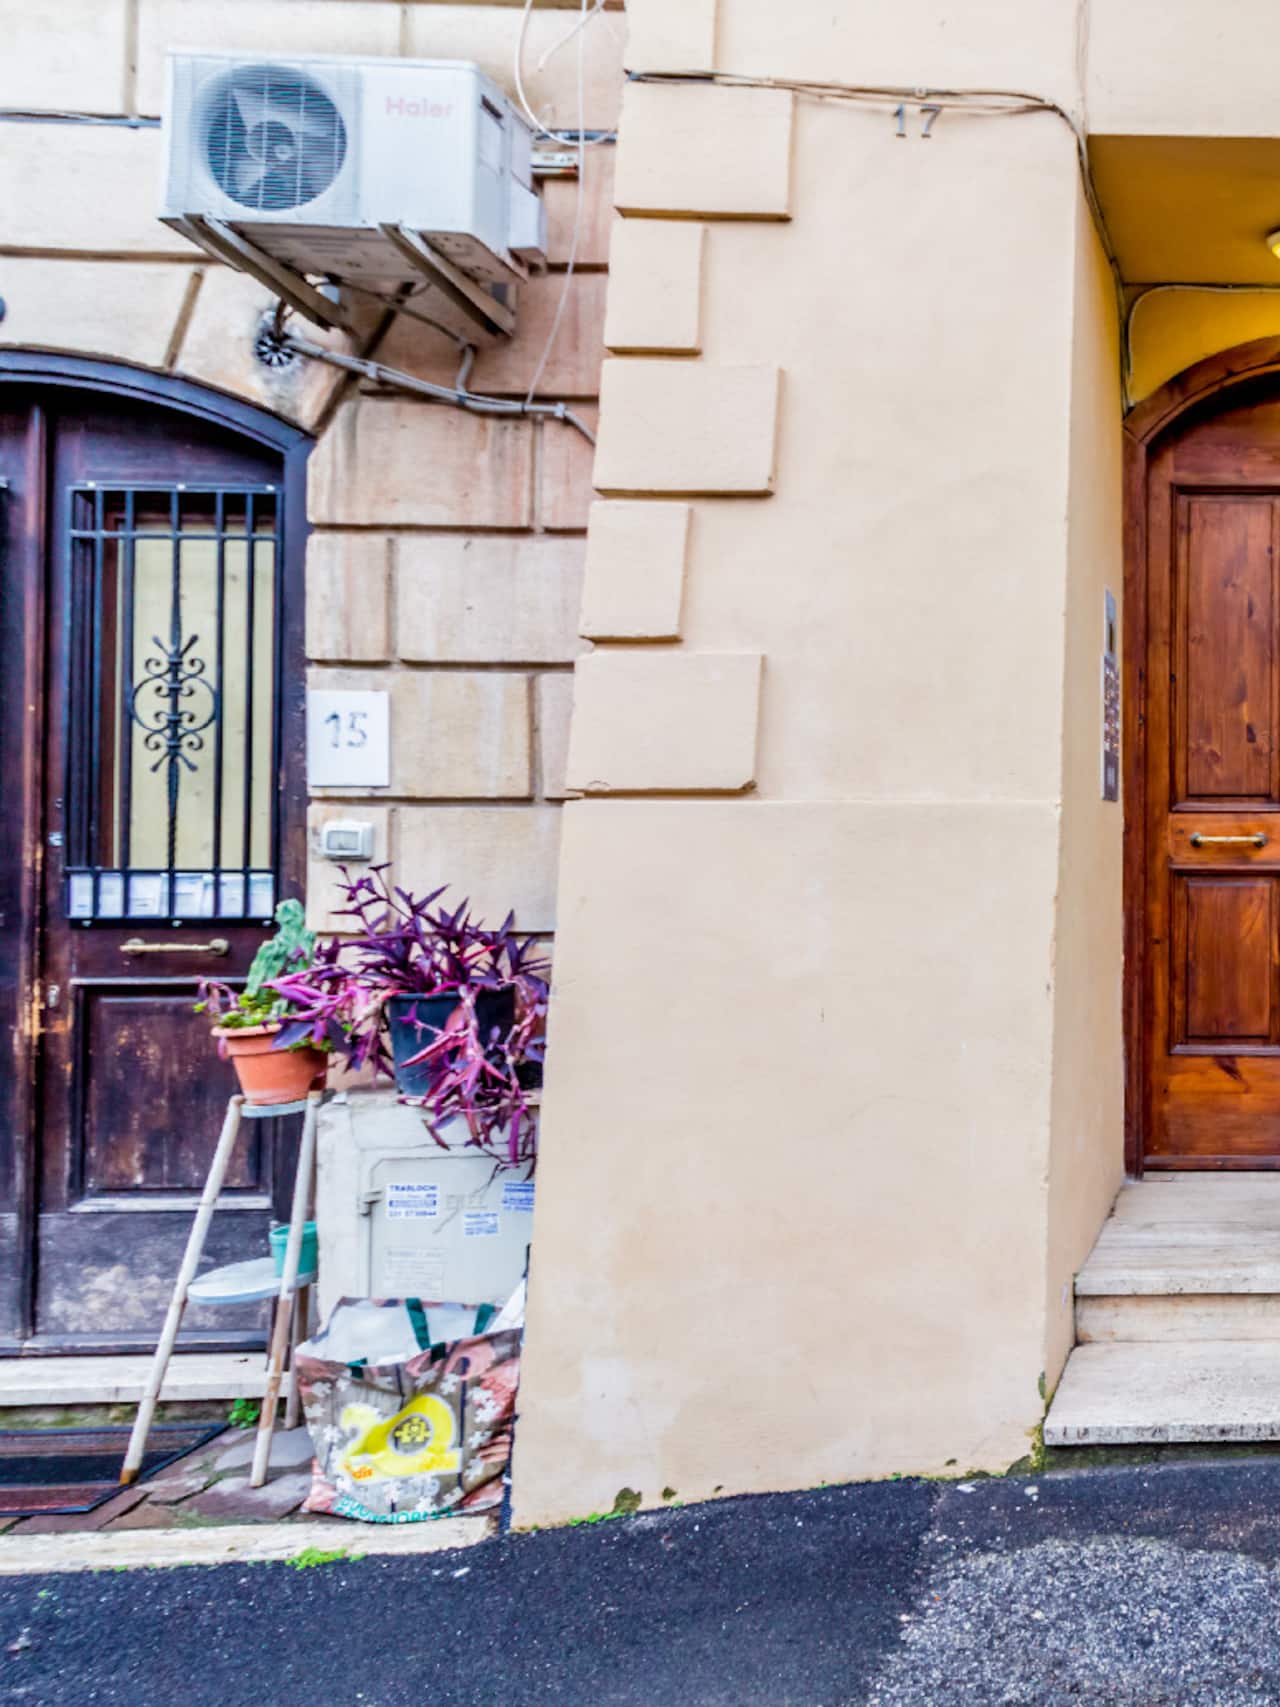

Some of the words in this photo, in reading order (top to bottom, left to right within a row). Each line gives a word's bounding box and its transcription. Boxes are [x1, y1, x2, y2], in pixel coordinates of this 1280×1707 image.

[385, 96, 456, 118] Haier
[893, 103, 943, 138] 17
[325, 711, 368, 749] 15
